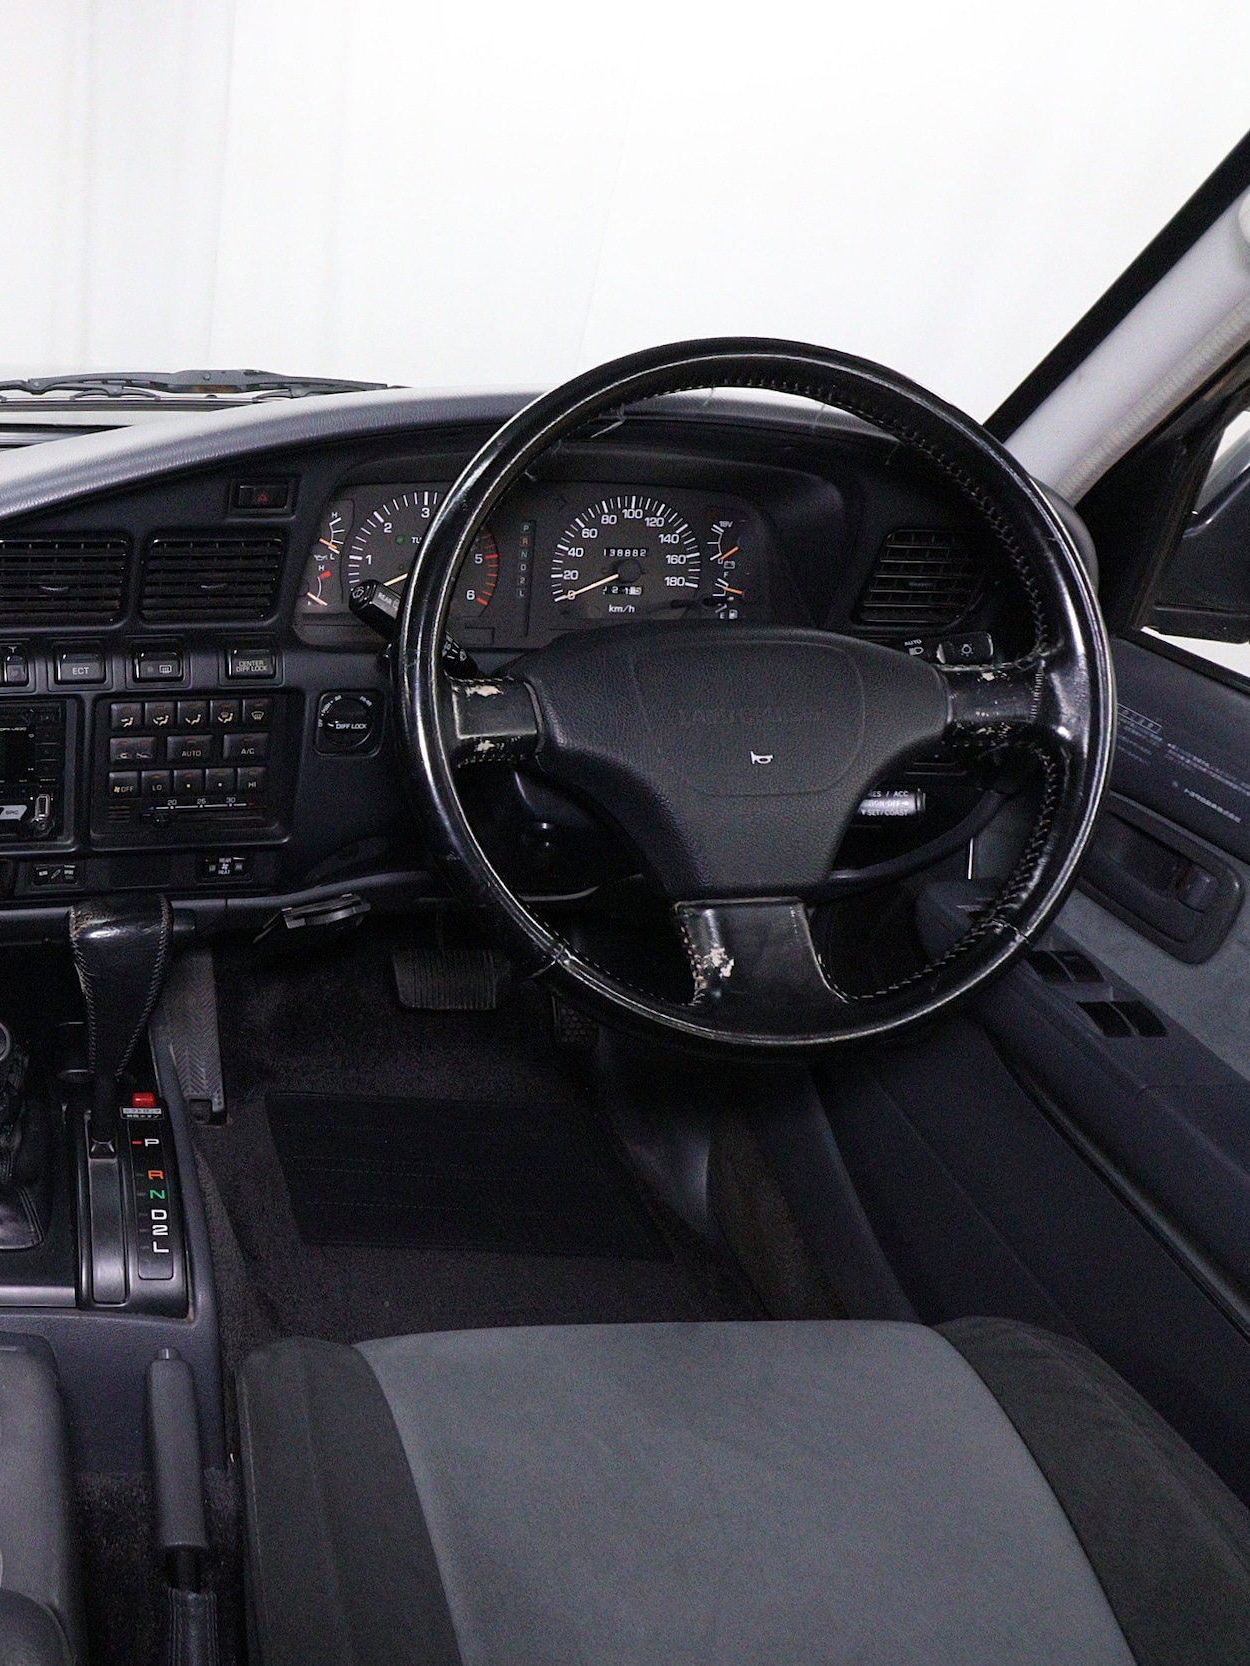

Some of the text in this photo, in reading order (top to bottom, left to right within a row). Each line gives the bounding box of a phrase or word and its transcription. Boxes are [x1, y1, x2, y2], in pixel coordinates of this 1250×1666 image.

[421, 507, 430, 518] 3
[621, 509, 643, 519] 100
[601, 515, 617, 525] 80
[644, 517, 665, 527] 120
[384, 522, 393, 533] 2
[581, 528, 598, 538] 60
[658, 534, 680, 544] 140
[567, 547, 584, 557] 40
[603, 549, 647, 557] 138882
[366, 555, 372, 565] 1
[474, 554, 483, 564] 5
[665, 554, 686, 565] 160
[563, 570, 579, 580] 20
[664, 576, 685, 587] 180
[466, 590, 475, 600] 6
[608, 604, 635, 613] km/h
[72, 667, 90, 675] ECT
[893, 790, 909, 798] ACC
[144, 1138, 160, 1147] P
[148, 1170, 165, 1180] R
[150, 1190, 165, 1199] N
[151, 1209, 167, 1220] D
[152, 1225, 168, 1236] 2
[153, 1241, 169, 1253] L
